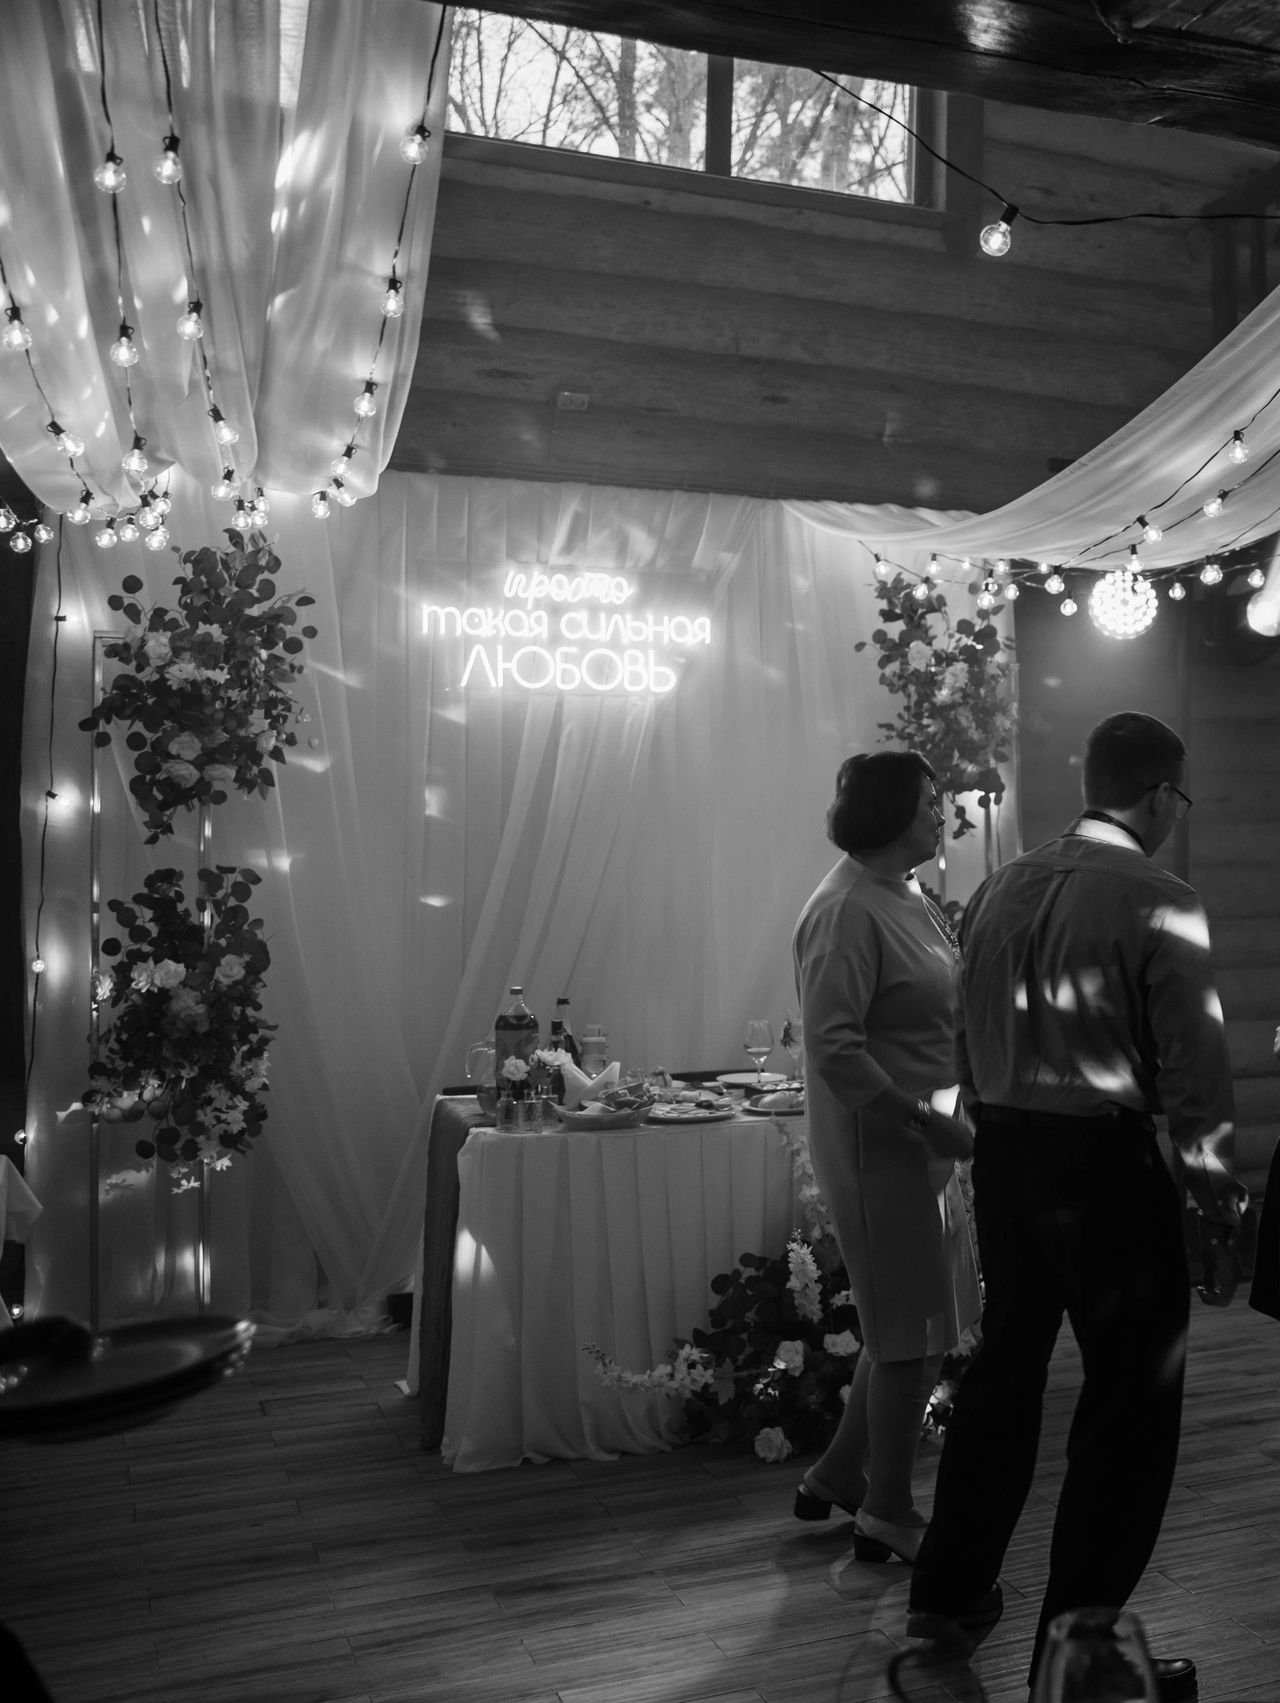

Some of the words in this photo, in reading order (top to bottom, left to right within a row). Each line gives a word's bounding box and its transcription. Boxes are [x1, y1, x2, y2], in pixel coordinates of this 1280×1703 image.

[503, 570, 634, 609] просто
[421, 603, 549, 638] такая
[559, 610, 712, 645] сильная
[460, 644, 678, 693] ЛЮБОВЬ
